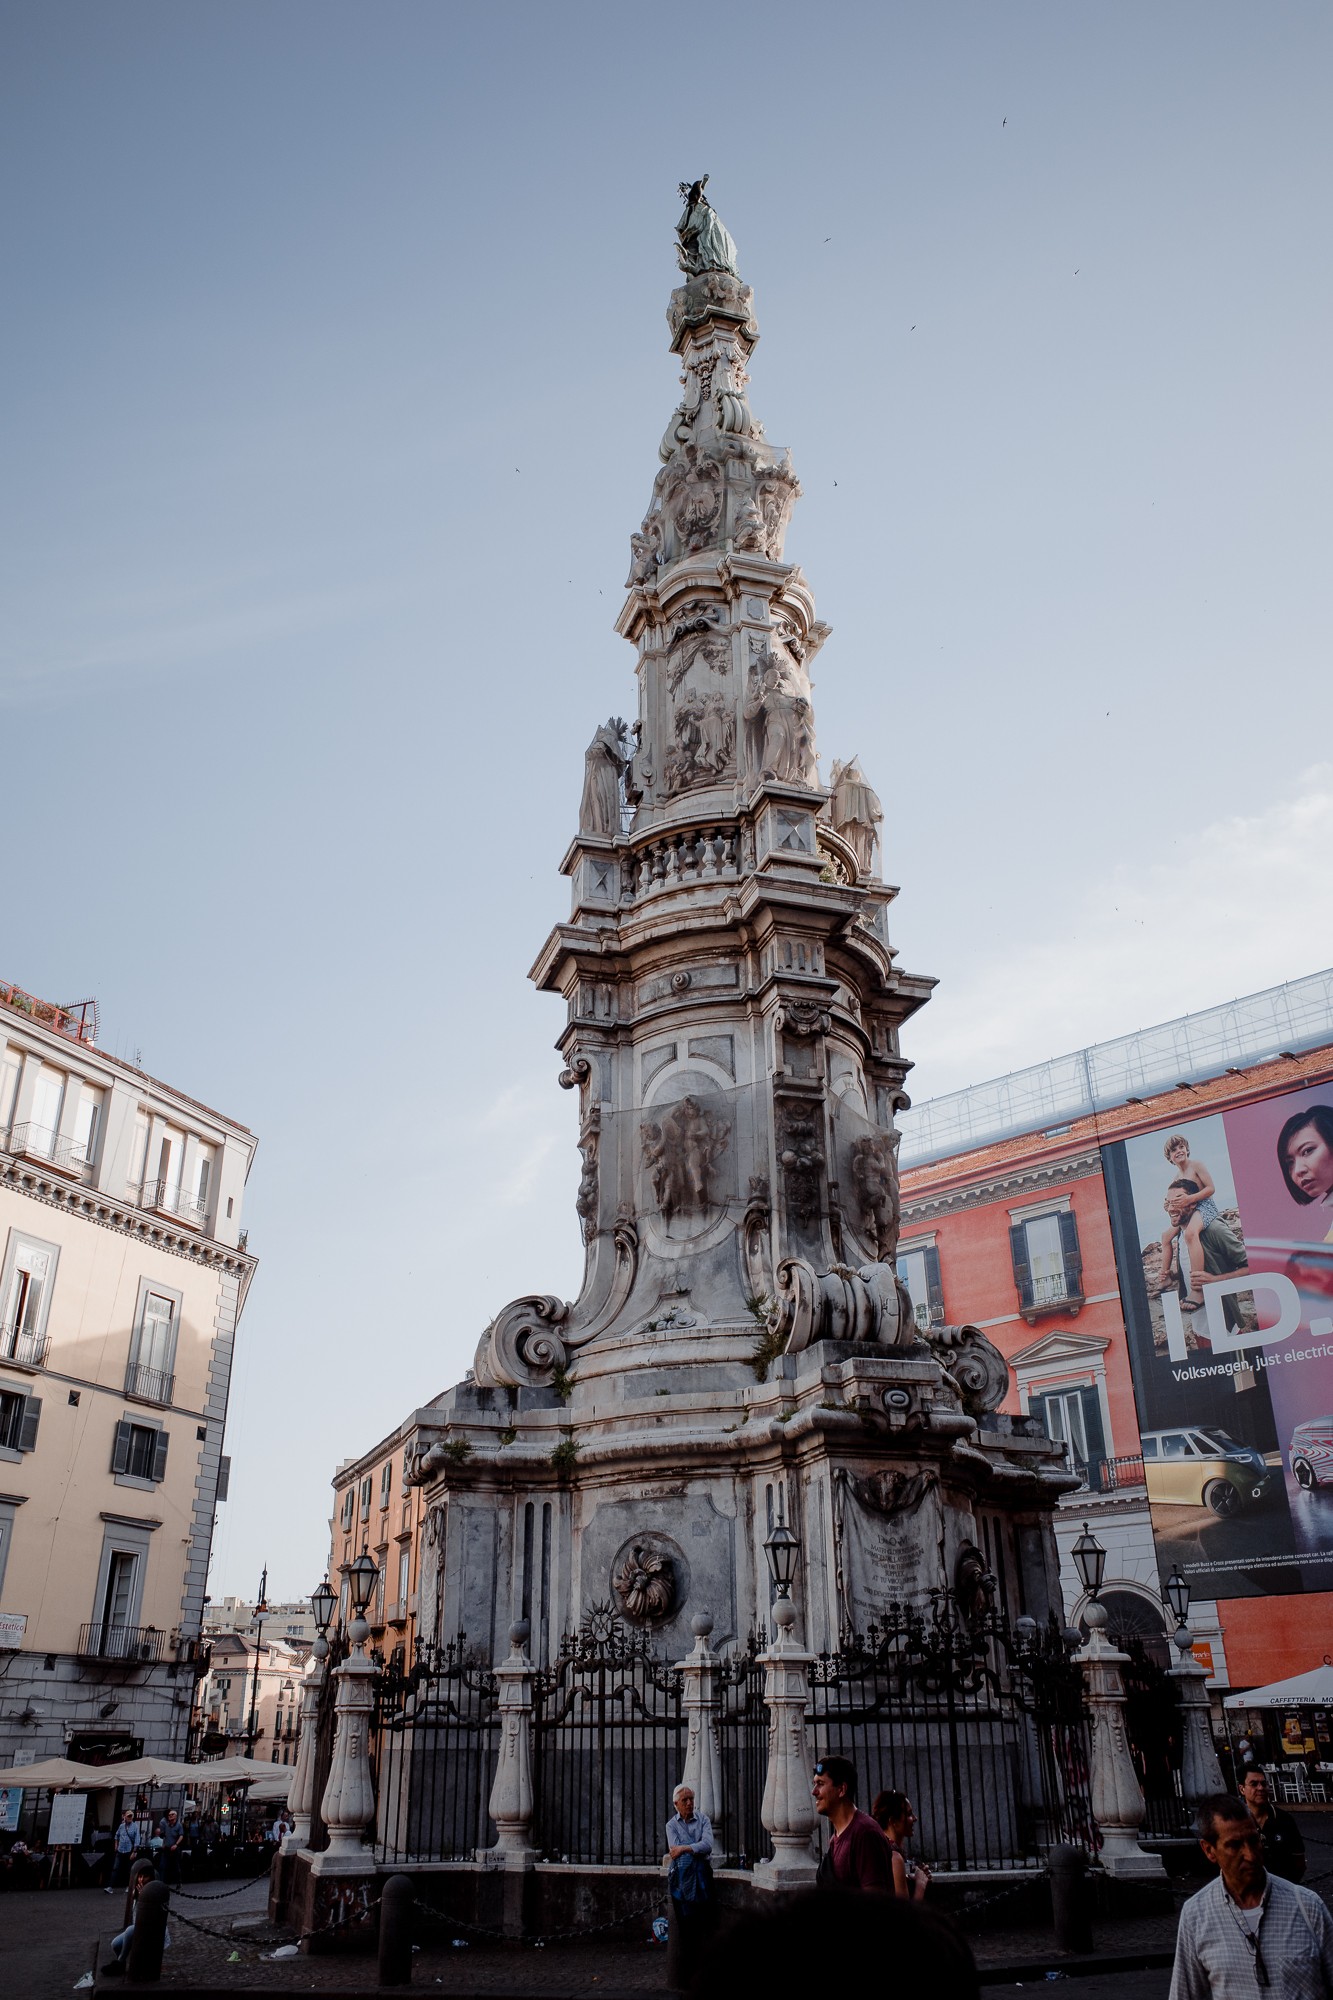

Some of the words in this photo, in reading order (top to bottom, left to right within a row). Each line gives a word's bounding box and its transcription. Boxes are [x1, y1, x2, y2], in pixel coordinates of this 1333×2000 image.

[1161, 1272, 1333, 1362] ID.
[1172, 1360, 1253, 1381] Volkswagen,
[1255, 1355, 1281, 1371] just
[1284, 1344, 1333, 1363] electric
[1269, 1696, 1316, 1704] CAFFETTERIA
